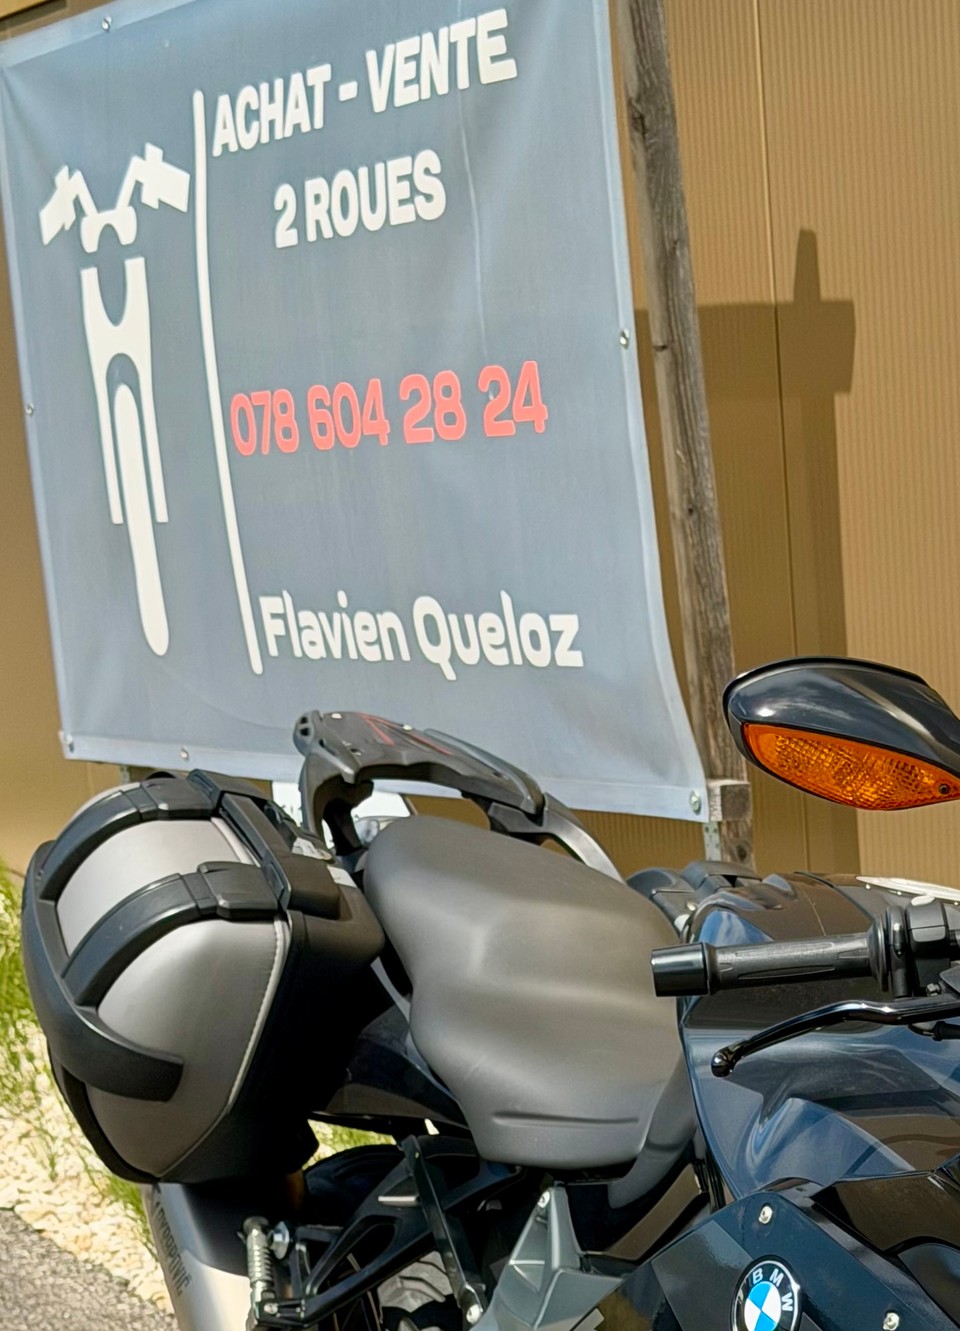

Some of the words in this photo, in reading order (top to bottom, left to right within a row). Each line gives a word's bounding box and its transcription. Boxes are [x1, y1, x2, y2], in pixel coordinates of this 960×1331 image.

[212, 64, 332, 157] ACHAT
[365, 8, 518, 113] VENTE
[274, 183, 298, 249] 2
[304, 149, 446, 242] ROUES
[230, 389, 299, 457] 078
[307, 378, 390, 451] 604
[399, 370, 467, 444] 28
[477, 360, 549, 437] 24
[259, 590, 411, 662] Flavien
[412, 590, 584, 681] Queloz
[751, 1267, 795, 1313] BMW
